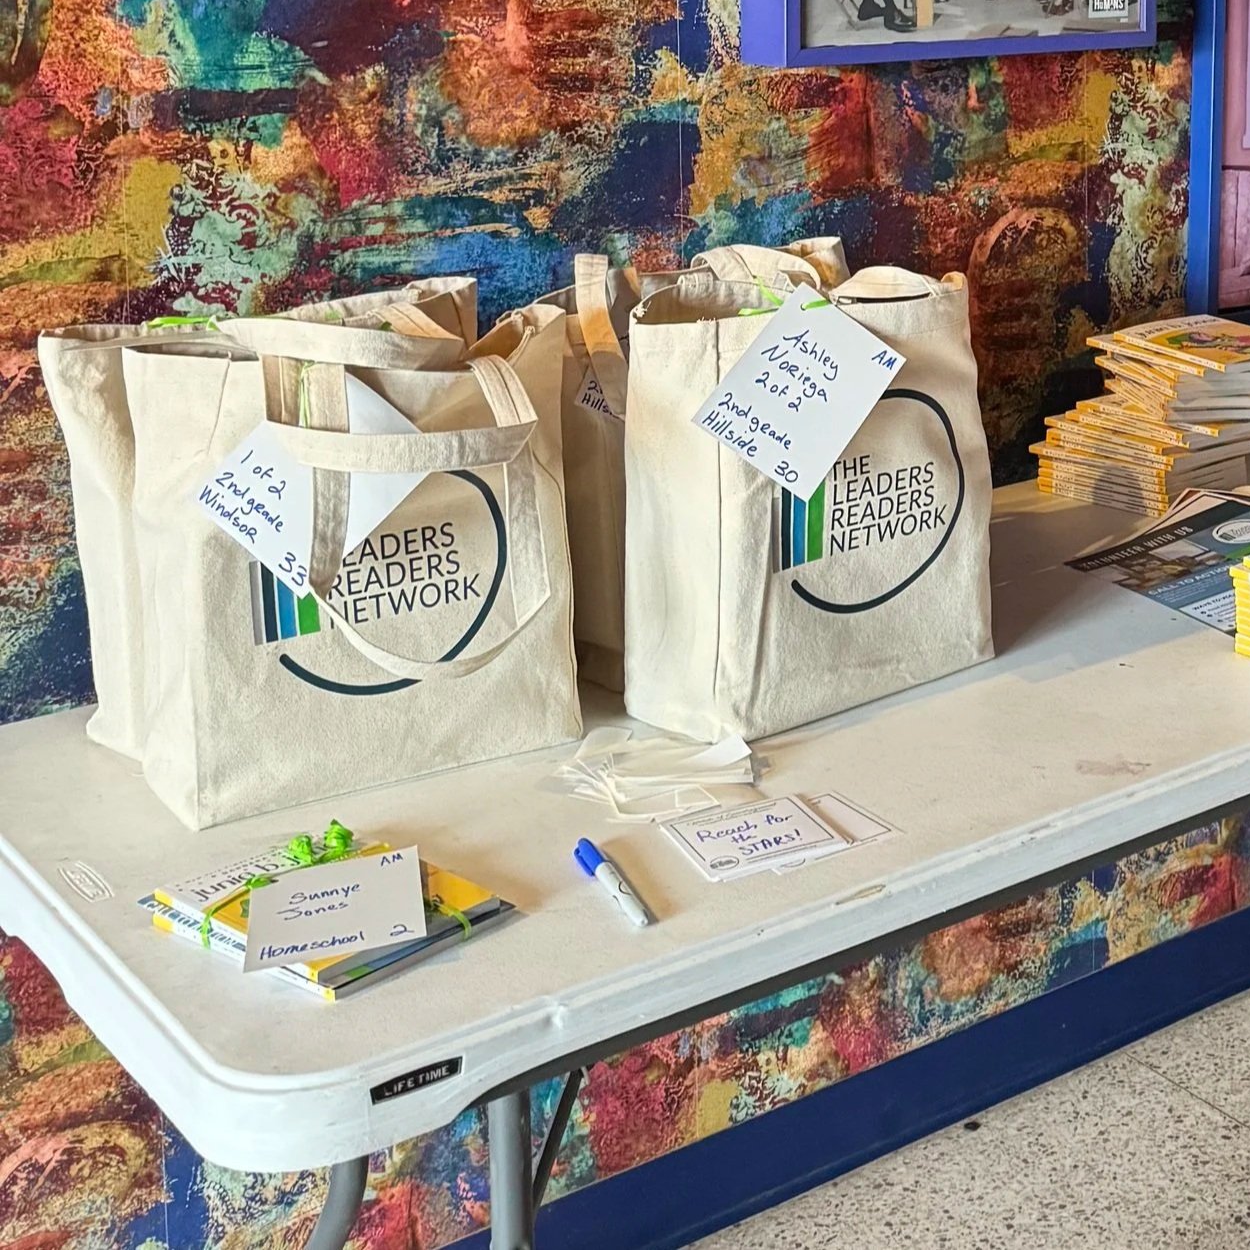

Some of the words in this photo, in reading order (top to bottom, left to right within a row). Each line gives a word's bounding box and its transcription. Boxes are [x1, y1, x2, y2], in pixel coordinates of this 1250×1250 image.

[782, 329, 838, 381] Ashley
[871, 350, 897, 371] AM
[718, 392, 752, 418] 2nd
[755, 371, 769, 385] 2
[769, 384, 789, 397] of
[788, 396, 802, 412] 2
[702, 410, 759, 458] Hillside
[215, 471, 250, 499] 2nd
[240, 449, 254, 464] 1
[252, 465, 274, 479] of
[267, 480, 287, 500] 2
[774, 461, 799, 483] 30
[832, 455, 870, 482] THE
[833, 462, 934, 506] LEADERS
[831, 485, 935, 531] READERS
[342, 522, 455, 568] EADERS
[829, 504, 947, 556] NETWORK
[1082, 545, 1146, 570] VOLUNTEER
[1144, 533, 1176, 549] WITH
[1174, 525, 1194, 537] US
[278, 551, 307, 587] 33
[328, 550, 460, 600] READERS
[1148, 583, 1176, 596] CALL
[1179, 577, 1195, 587] TO
[696, 819, 758, 842] Reach
[738, 828, 803, 857] STARS!
[379, 852, 404, 867] AM
[276, 899, 350, 921] Jones
[288, 881, 362, 907] Sunnye
[258, 930, 366, 961] Homeschool
[389, 923, 415, 938] 2
